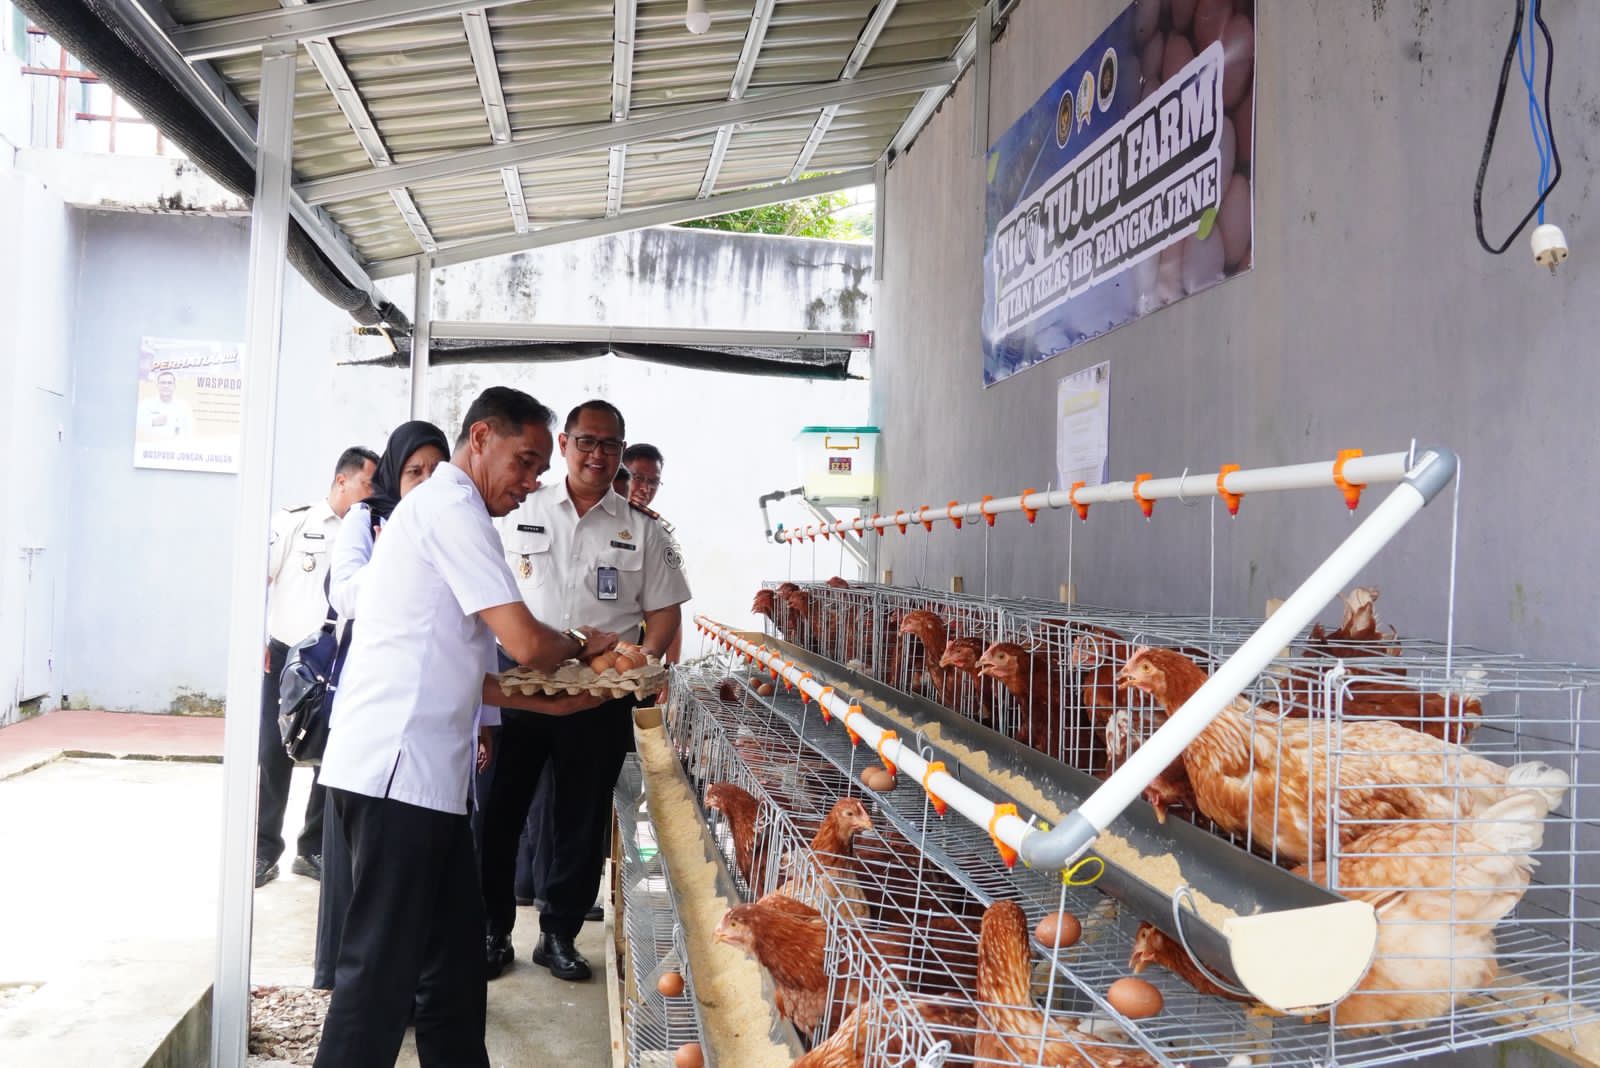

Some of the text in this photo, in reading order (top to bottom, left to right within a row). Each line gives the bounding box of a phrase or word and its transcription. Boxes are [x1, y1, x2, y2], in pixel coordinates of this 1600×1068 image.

[1044, 140, 1120, 245] TUJUH
[1126, 70, 1216, 189] FARM
[1034, 256, 1070, 305] KELAS
[1072, 240, 1093, 282] IIB
[1095, 163, 1216, 268] PANGKAJENE
[197, 376, 242, 390] WASPADA
